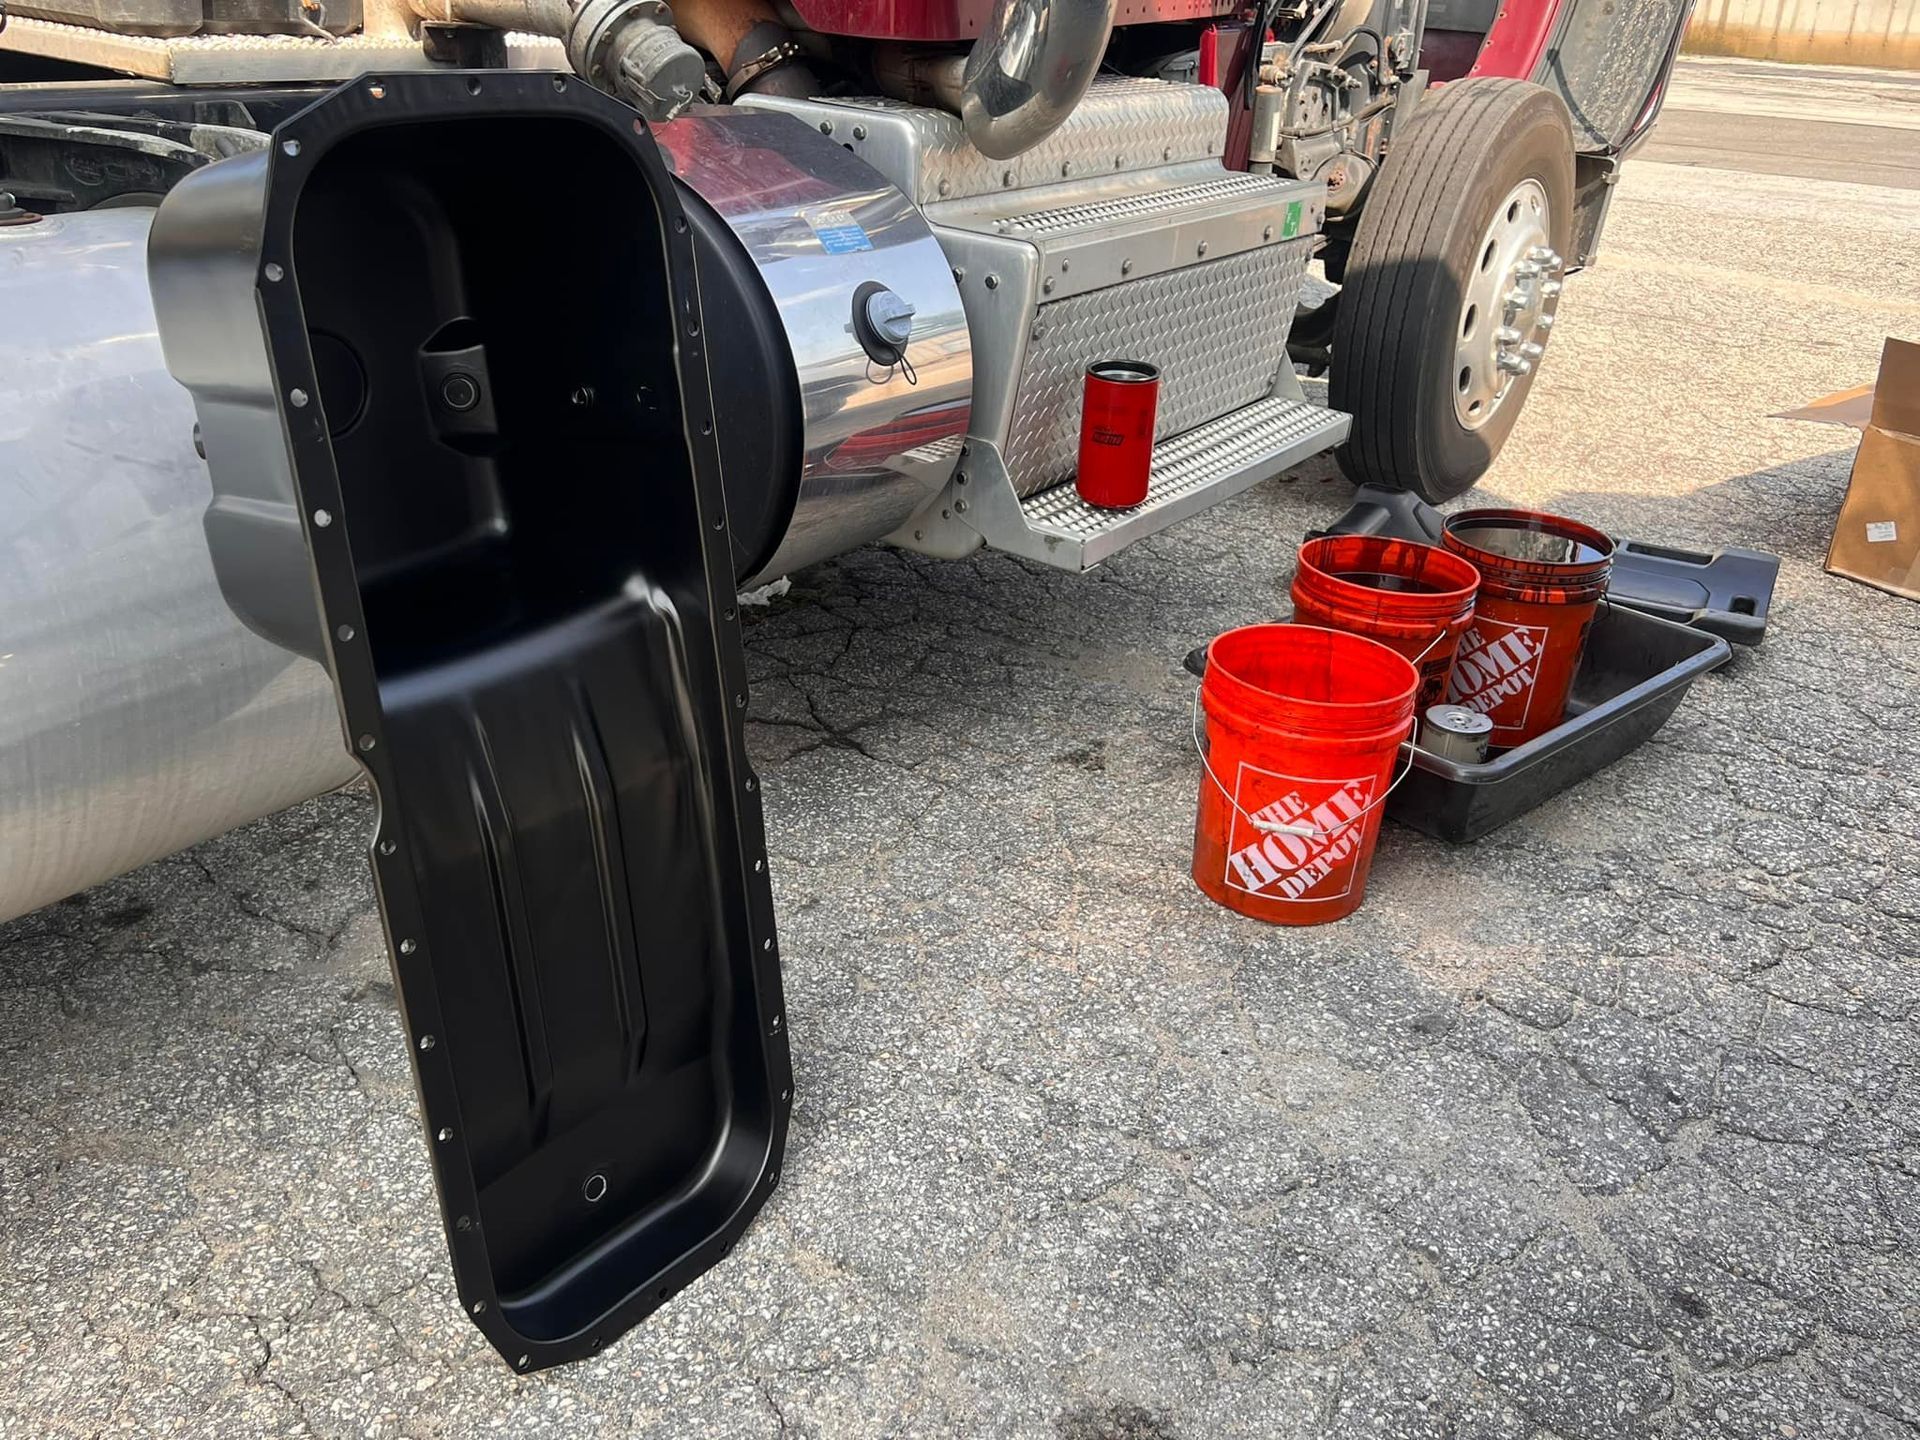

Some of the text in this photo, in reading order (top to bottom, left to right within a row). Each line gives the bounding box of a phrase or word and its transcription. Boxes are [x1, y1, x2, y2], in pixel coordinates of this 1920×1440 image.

[1459, 627, 1486, 657] HE
[1230, 781, 1371, 892] HOME
[1249, 790, 1310, 835] THE
[1277, 823, 1361, 899] DEPOT
